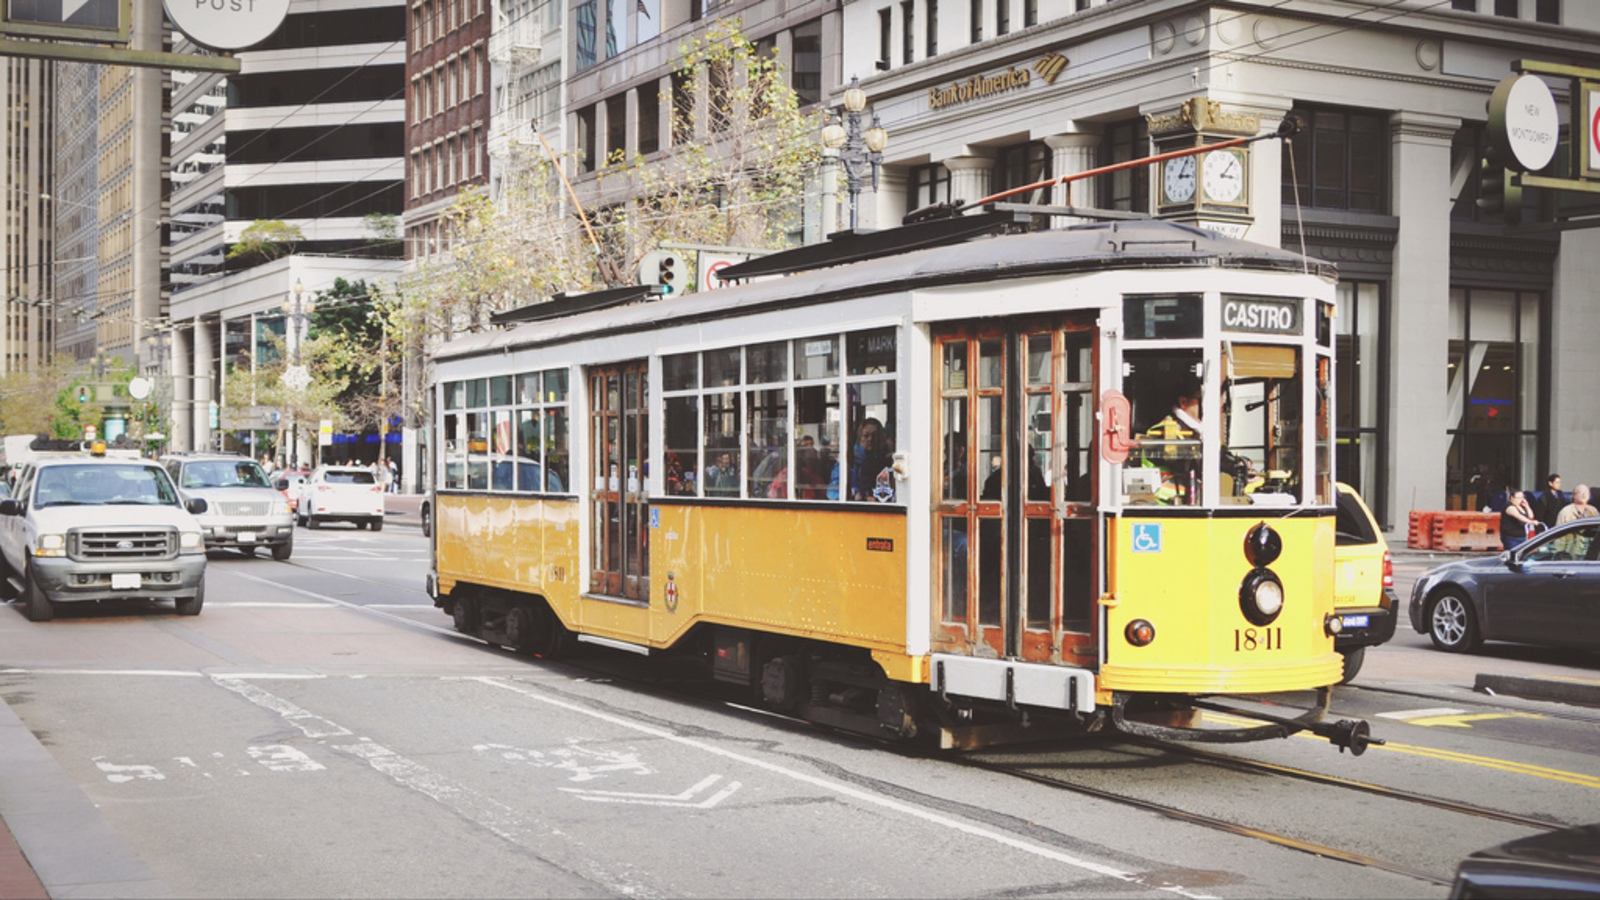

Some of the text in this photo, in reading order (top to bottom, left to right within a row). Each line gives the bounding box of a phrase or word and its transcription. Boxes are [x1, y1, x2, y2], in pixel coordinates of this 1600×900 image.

[195, 0, 256, 12] POST
[928, 66, 1030, 110] Bank of America
[1524, 104, 1540, 117] NEW
[1511, 127, 1552, 144] MONTGOMERY
[1144, 299, 1178, 337] F
[1224, 302, 1292, 329] CASTRO
[1235, 627, 1282, 651] 1811
